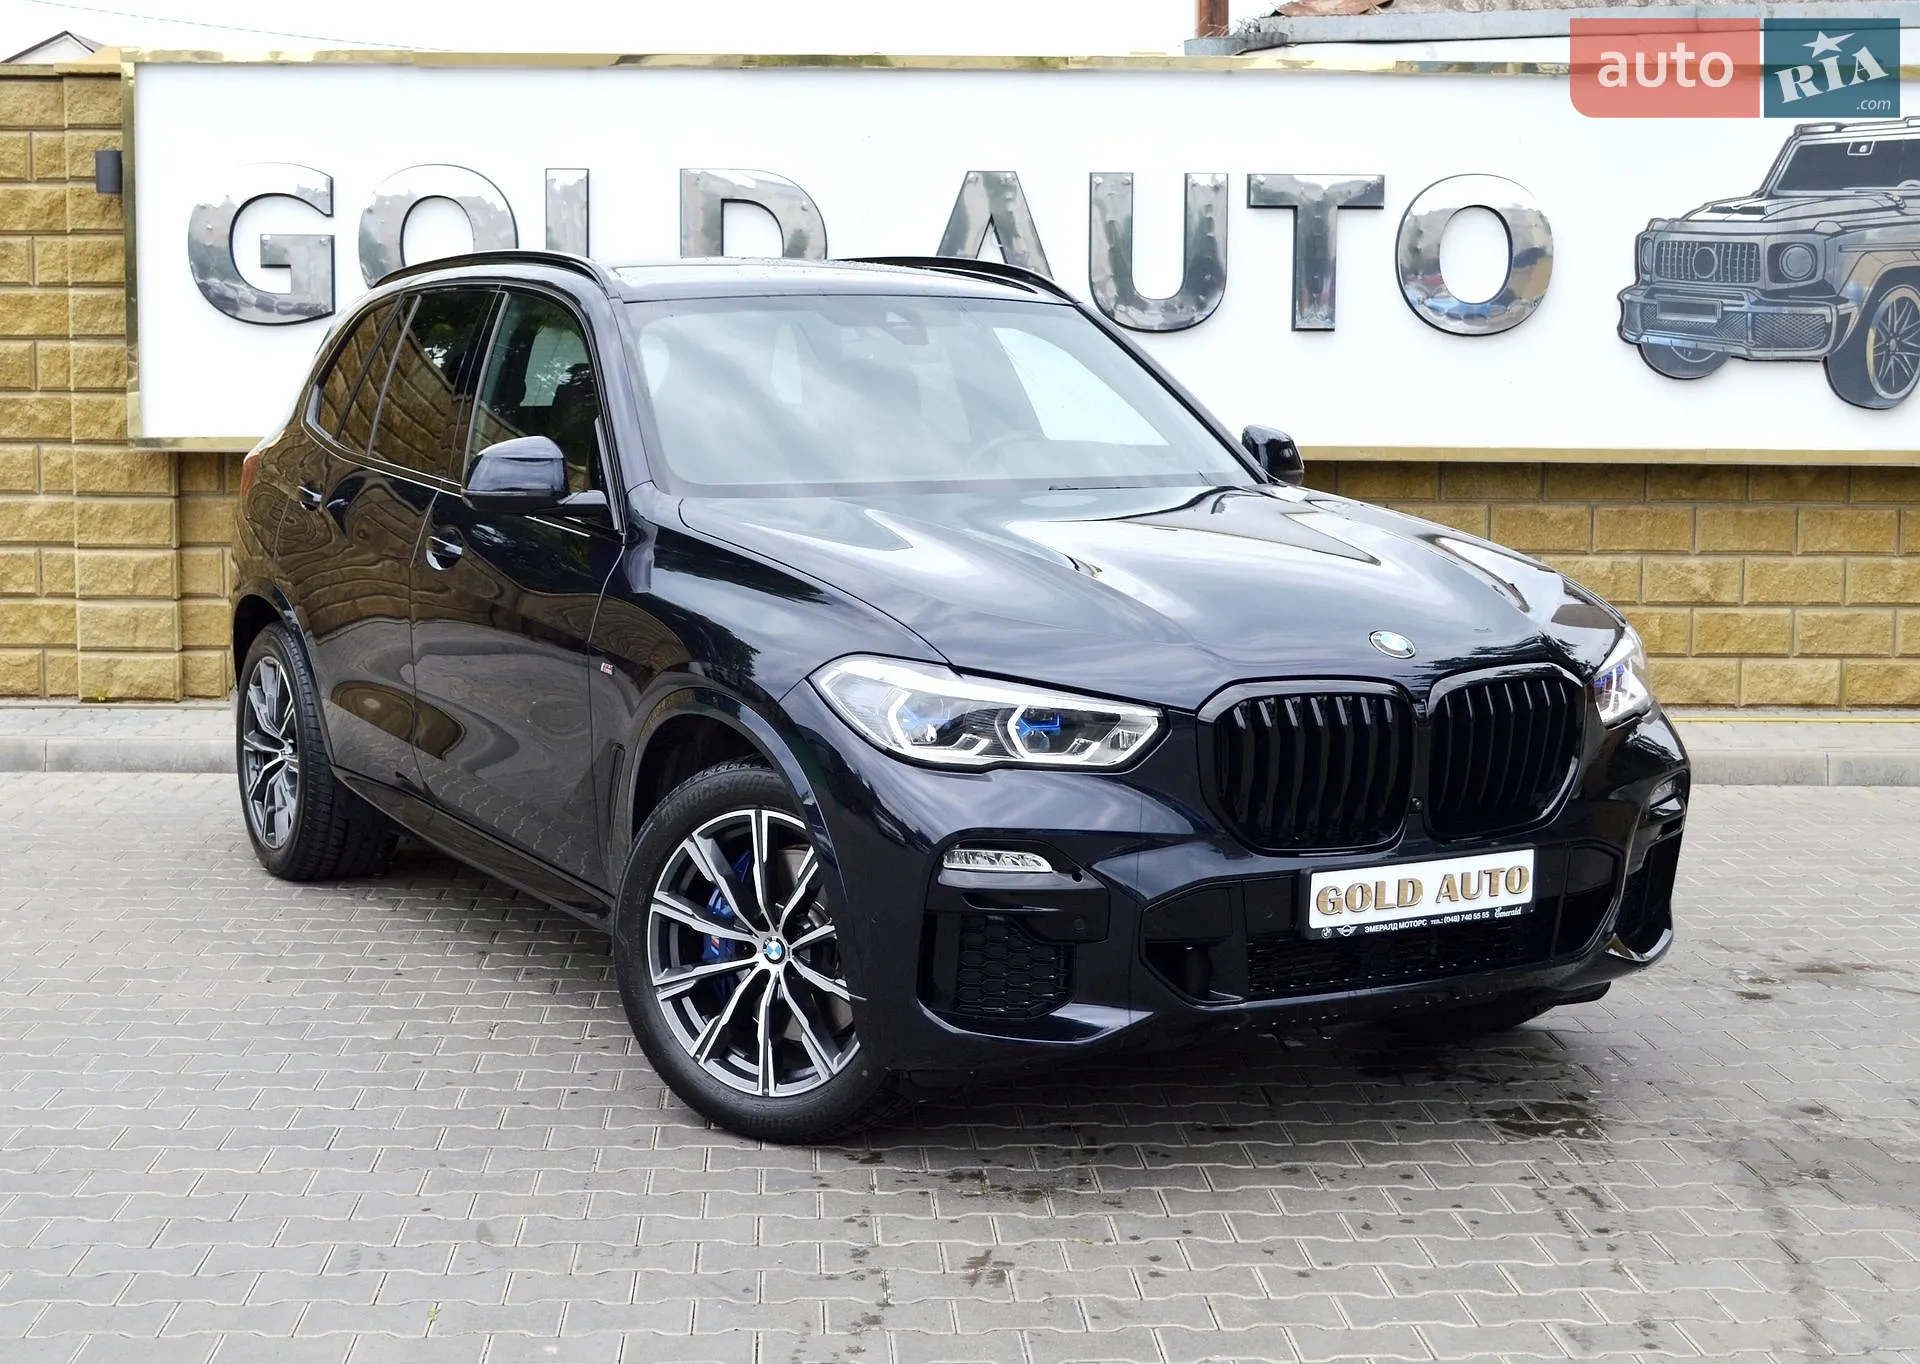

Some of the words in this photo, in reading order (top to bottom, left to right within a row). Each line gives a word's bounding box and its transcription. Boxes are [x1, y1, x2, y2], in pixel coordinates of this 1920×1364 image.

[936, 170, 1553, 336] AUTO
[1316, 877, 1424, 915] GOLD
[1436, 865, 1530, 903] AUTO
[1364, 922, 1398, 933] ЭМЕРАЛД
[1399, 919, 1428, 929] МОТОРС
[1444, 914, 1460, 924] (048)
[1461, 913, 1472, 921] 740
[1473, 912, 1481, 920] 55
[1482, 911, 1490, 919] 55
[1494, 906, 1522, 919] Emerald
